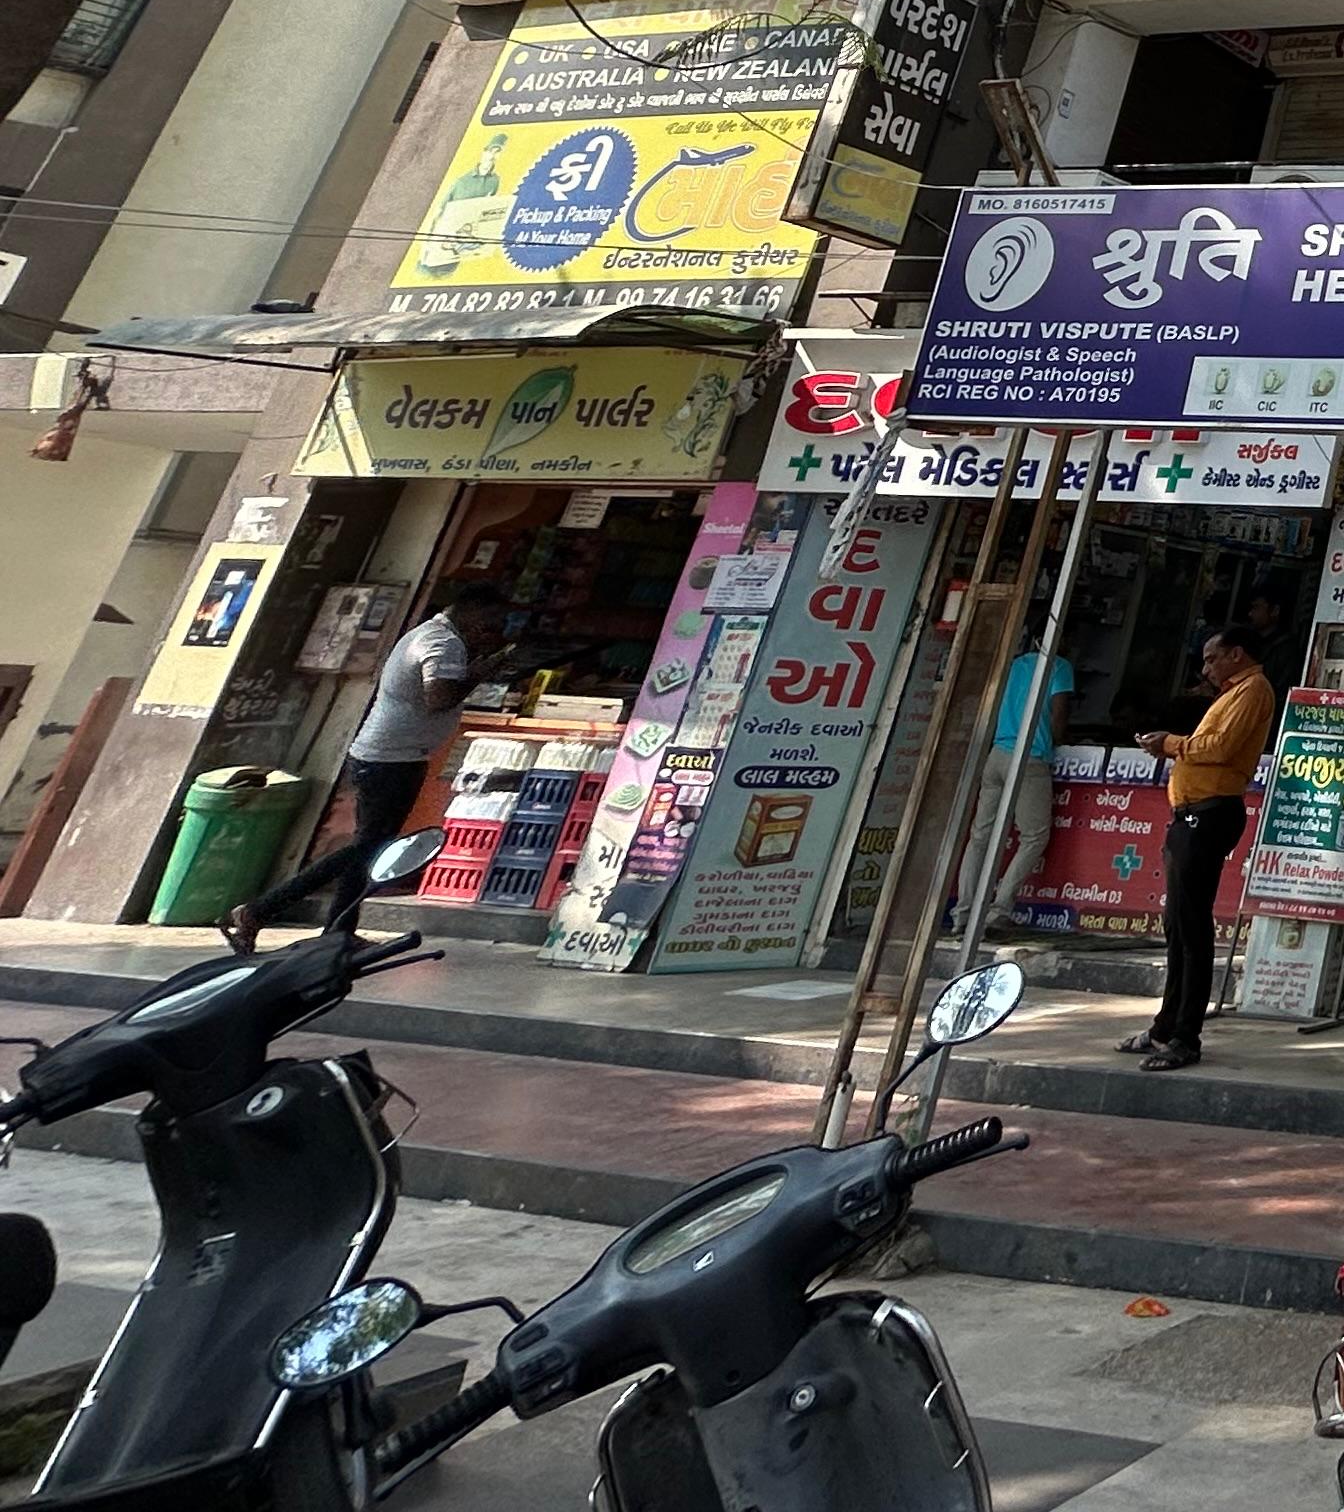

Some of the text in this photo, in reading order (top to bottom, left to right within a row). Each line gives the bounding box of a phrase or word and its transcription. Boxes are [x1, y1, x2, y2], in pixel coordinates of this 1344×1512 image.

[539, 44, 573, 63] UK
[604, 40, 650, 59] USA
[519, 58, 837, 92] AUSTRALIA NEW ZEALAN
[863, 90, 922, 156] સેવા
[977, 197, 1107, 211] MO. 8160517415
[513, 207, 551, 226] Pickup
[566, 205, 612, 226] Packing
[1091, 206, 1263, 310] श्रुति
[753, 285, 783, 312] 66
[935, 320, 1240, 344] SHRUTI VISPUTE (BASLP)
[929, 345, 1138, 366] (Audiologist & Speech
[923, 365, 1136, 386] Language Pathologist)
[917, 384, 1122, 404] RCI REG NO A70195
[385, 384, 656, 430] વેલકમ પાન પાર્લર
[1257, 399, 1278, 413] CIC
[1309, 401, 1329, 414] ITC
[1237, 438, 1300, 464] સર્જીકલ
[442, 455, 473, 472] ઠંડા
[530, 454, 593, 473] નમકીન
[742, 716, 865, 738] જેનરીક દવાઓ
[740, 769, 778, 785] લાલ
[1254, 850, 1284, 876] HK
[1282, 862, 1311, 879] Relax
